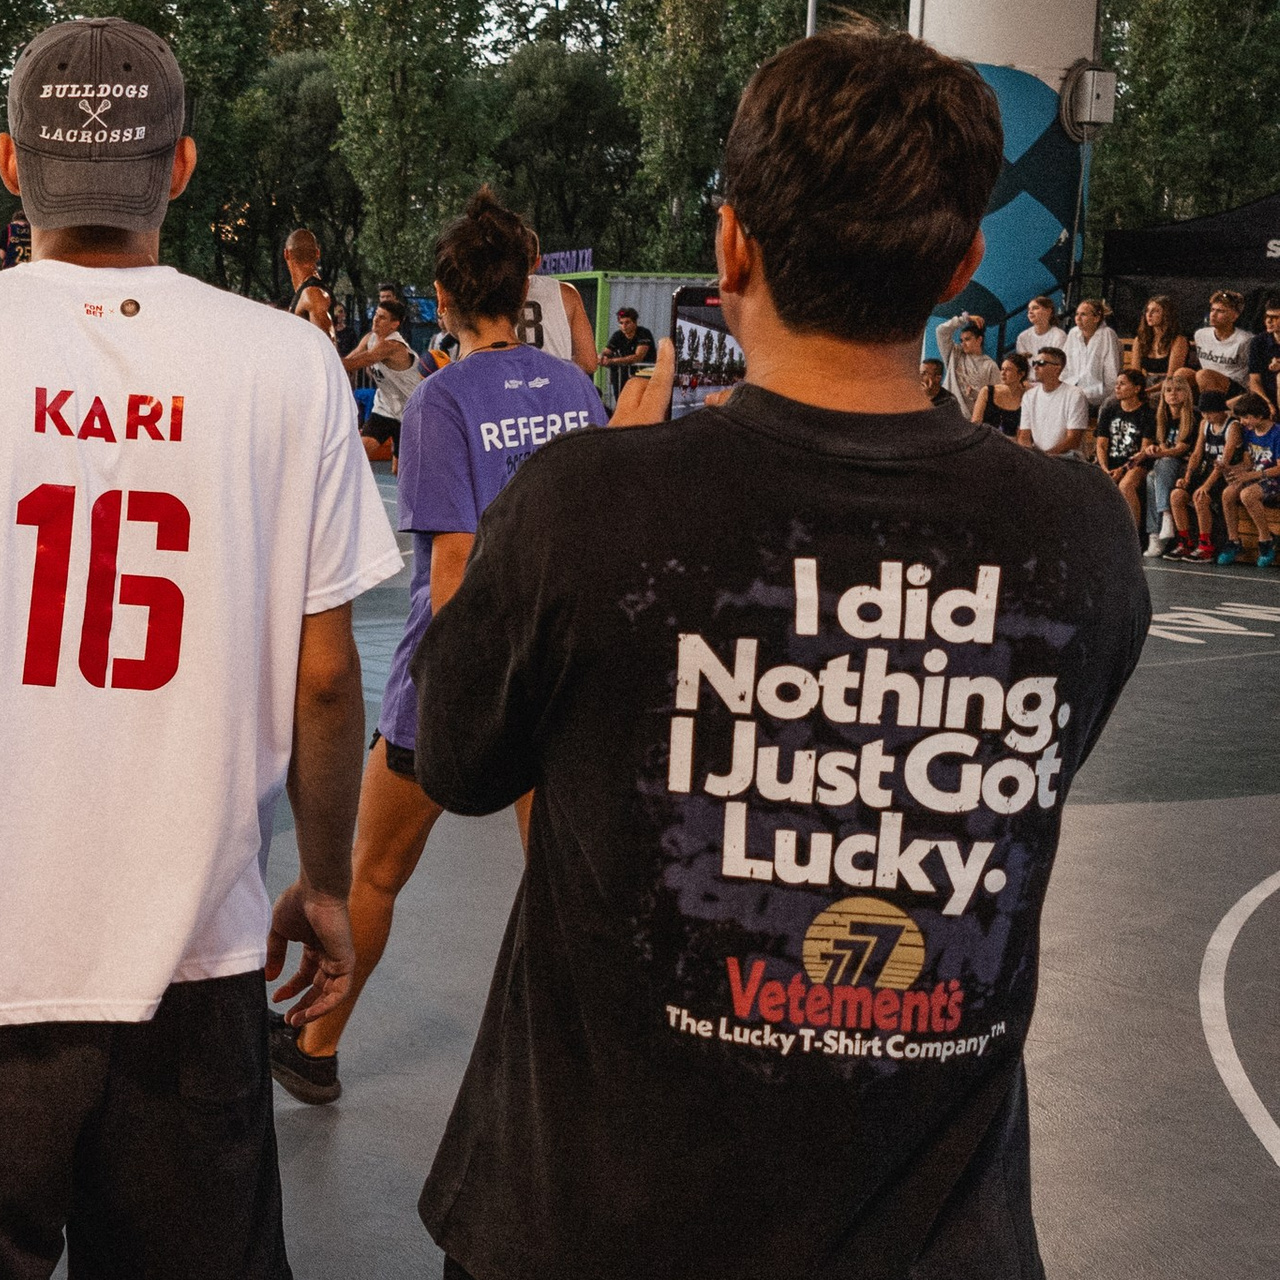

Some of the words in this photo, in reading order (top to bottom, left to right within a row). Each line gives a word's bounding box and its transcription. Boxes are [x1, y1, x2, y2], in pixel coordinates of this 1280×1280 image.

[40, 84, 149, 98] BULLDOGS
[39, 125, 146, 143] LACROSSE
[84, 303, 103, 311] FON
[86, 309, 104, 318] BET
[34, 387, 184, 443] KARI
[480, 411, 589, 452] REFEREE
[16, 483, 191, 690] 16
[794, 558, 818, 635] I
[837, 561, 1000, 644] did
[675, 634, 1070, 754] Nothing.
[668, 717, 694, 792] I
[704, 720, 894, 808] Just
[904, 732, 1062, 815] Got
[721, 801, 1007, 915] Lucky.
[666, 1006, 712, 1038] The
[720, 1017, 795, 1055] Lucky
[799, 1027, 882, 1058] T-Shirt
